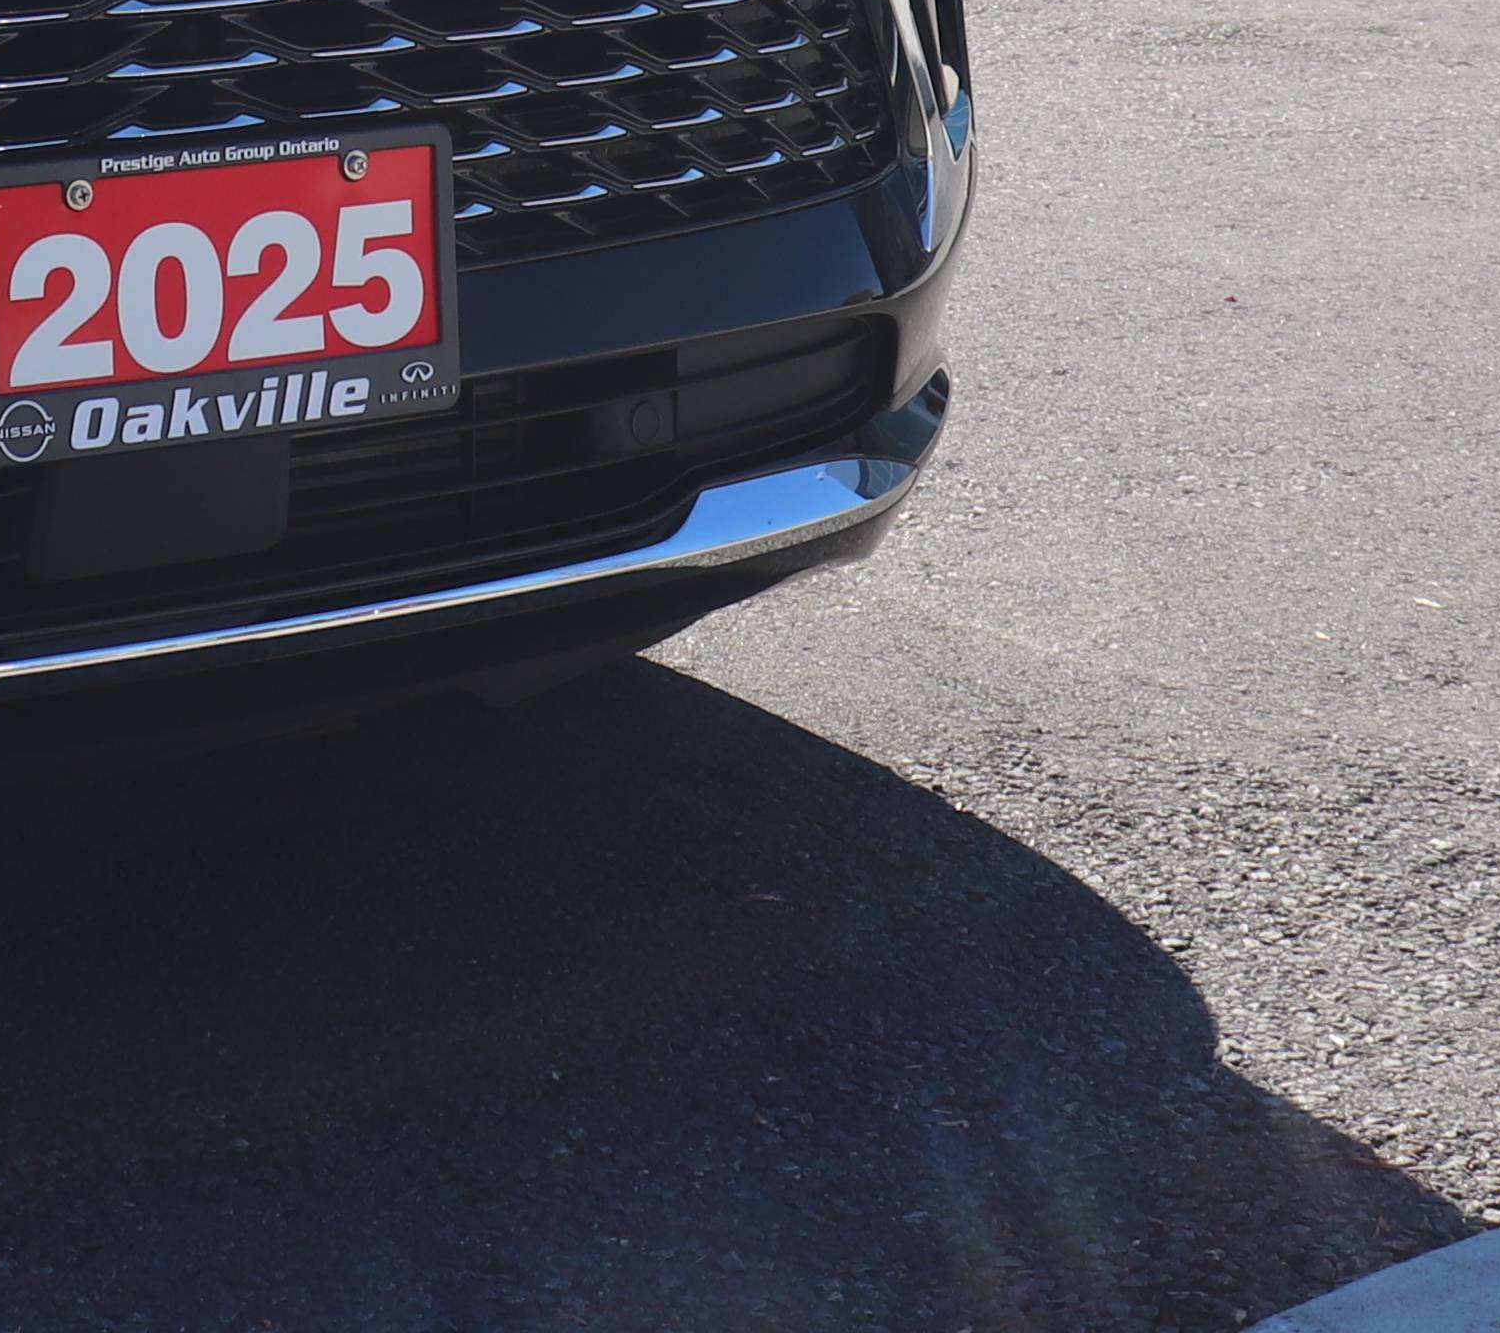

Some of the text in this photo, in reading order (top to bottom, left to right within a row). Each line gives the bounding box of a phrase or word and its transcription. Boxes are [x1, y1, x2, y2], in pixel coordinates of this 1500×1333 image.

[101, 137, 339, 174] Prestige Auto Group Ontario
[9, 199, 425, 389] 2025
[70, 370, 371, 451] Oakville
[380, 385, 457, 404] INFINITI
